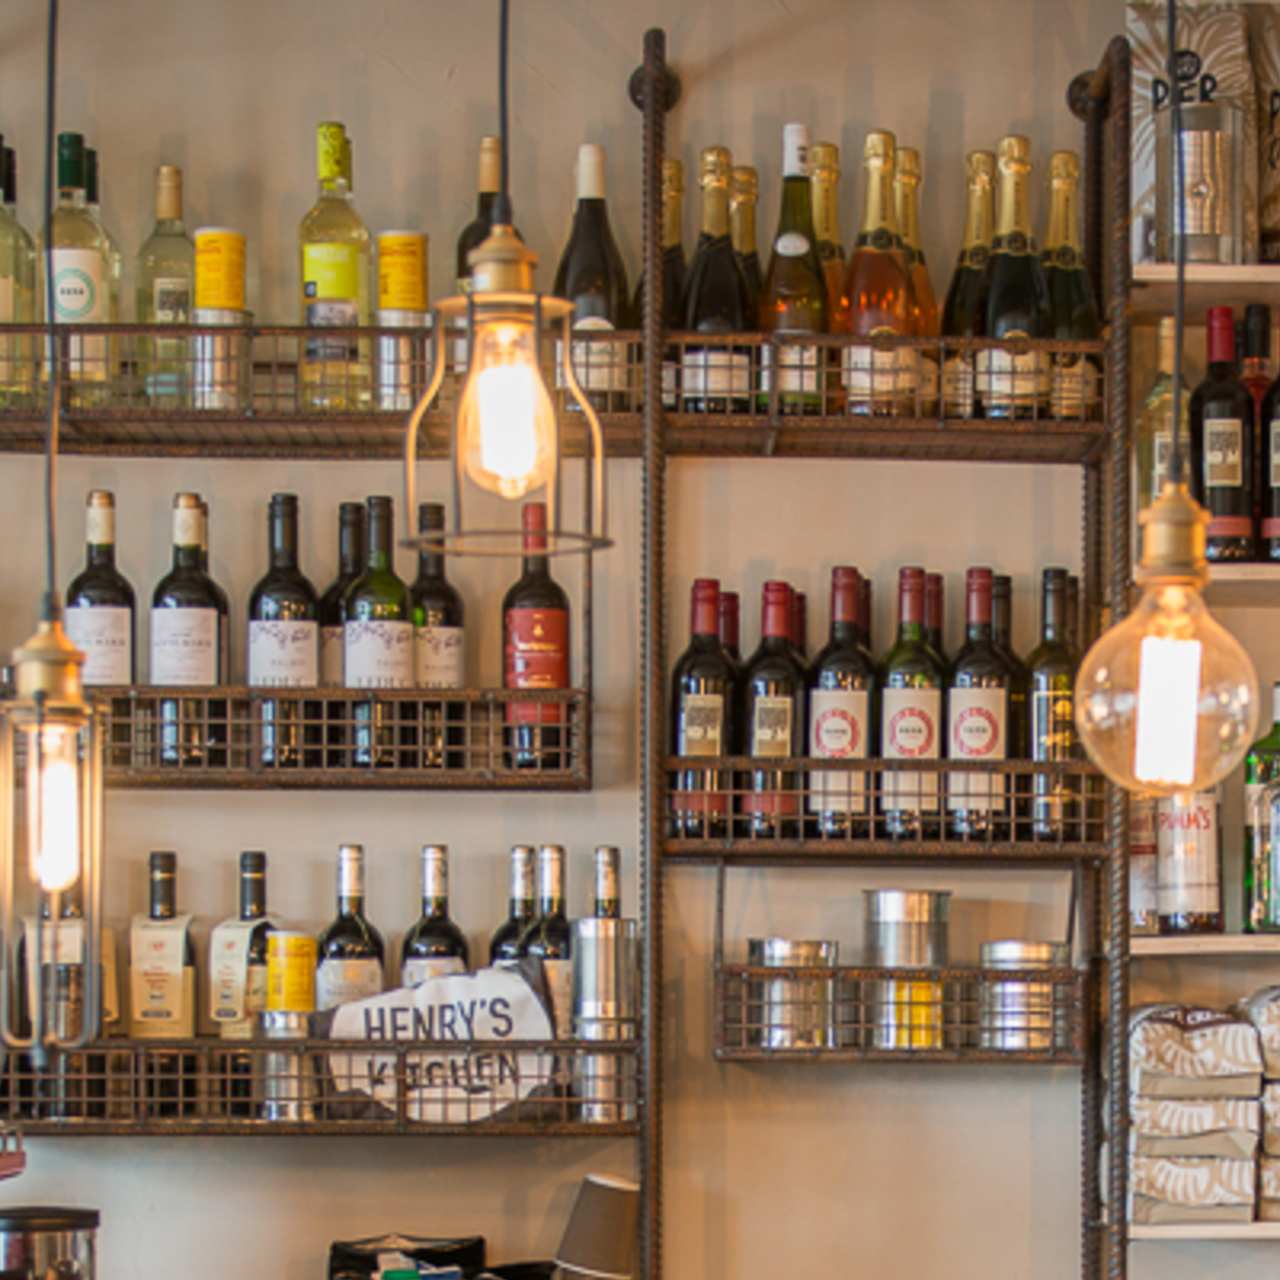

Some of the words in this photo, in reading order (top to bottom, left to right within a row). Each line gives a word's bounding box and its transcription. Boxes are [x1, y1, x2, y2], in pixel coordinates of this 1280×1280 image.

[1152, 74, 1217, 106] PER
[363, 997, 514, 1041] HENRY'S
[367, 1051, 519, 1092] KTCHEN
